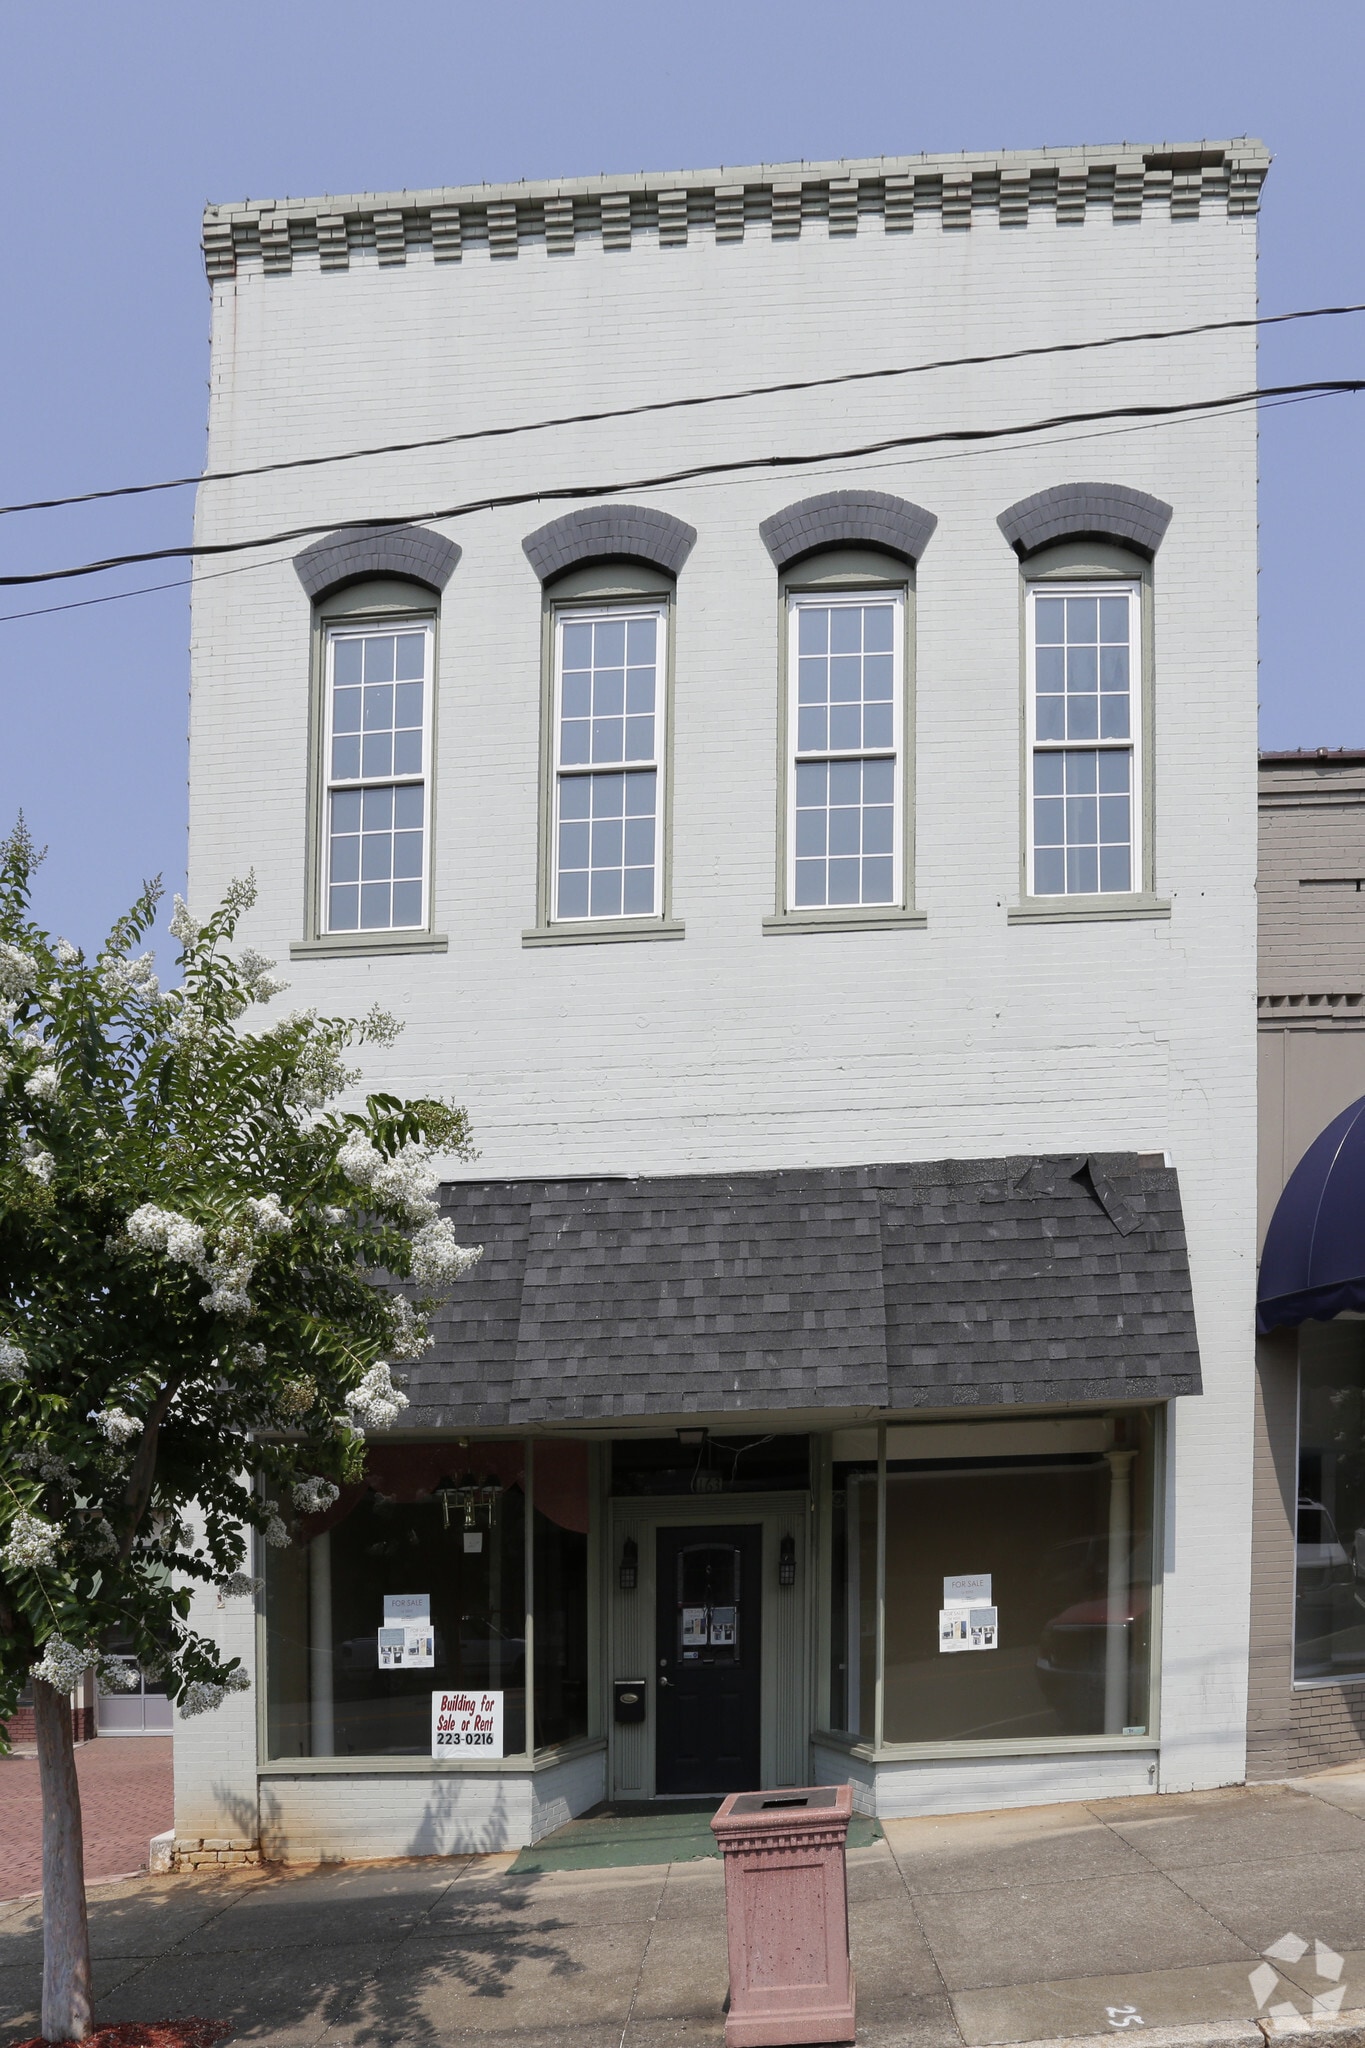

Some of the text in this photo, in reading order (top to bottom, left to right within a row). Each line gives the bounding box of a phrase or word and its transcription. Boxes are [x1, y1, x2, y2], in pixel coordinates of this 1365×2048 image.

[406, 1599, 423, 1607] SALE
[441, 1694, 495, 1716] Building for
[437, 1714, 494, 1731] Sale or Rent
[437, 1733, 493, 1744] 223-0216
[1105, 2005, 1145, 2027] 25
